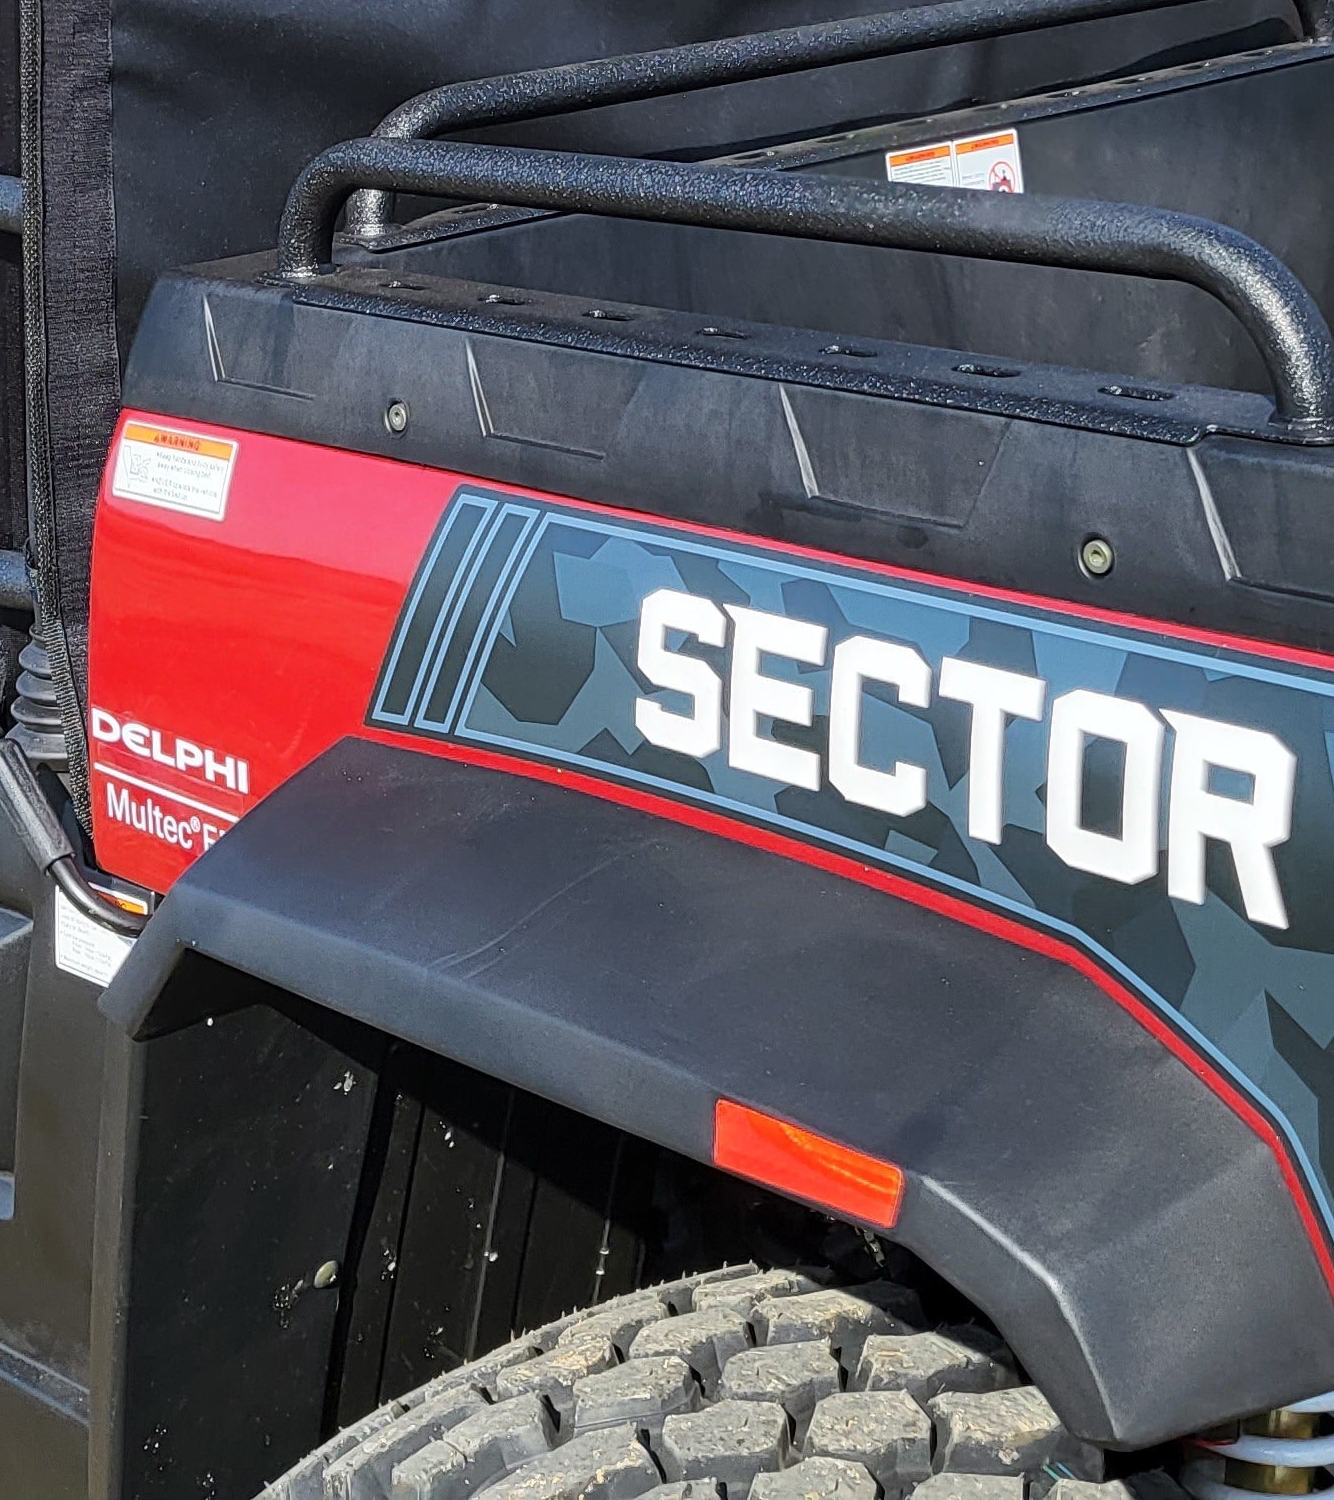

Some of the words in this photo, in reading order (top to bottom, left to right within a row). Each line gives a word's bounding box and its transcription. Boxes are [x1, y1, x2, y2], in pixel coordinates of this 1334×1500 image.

[160, 434, 201, 451] WARNING
[91, 707, 249, 795] DELPHI
[634, 588, 1298, 930] SECTOR
